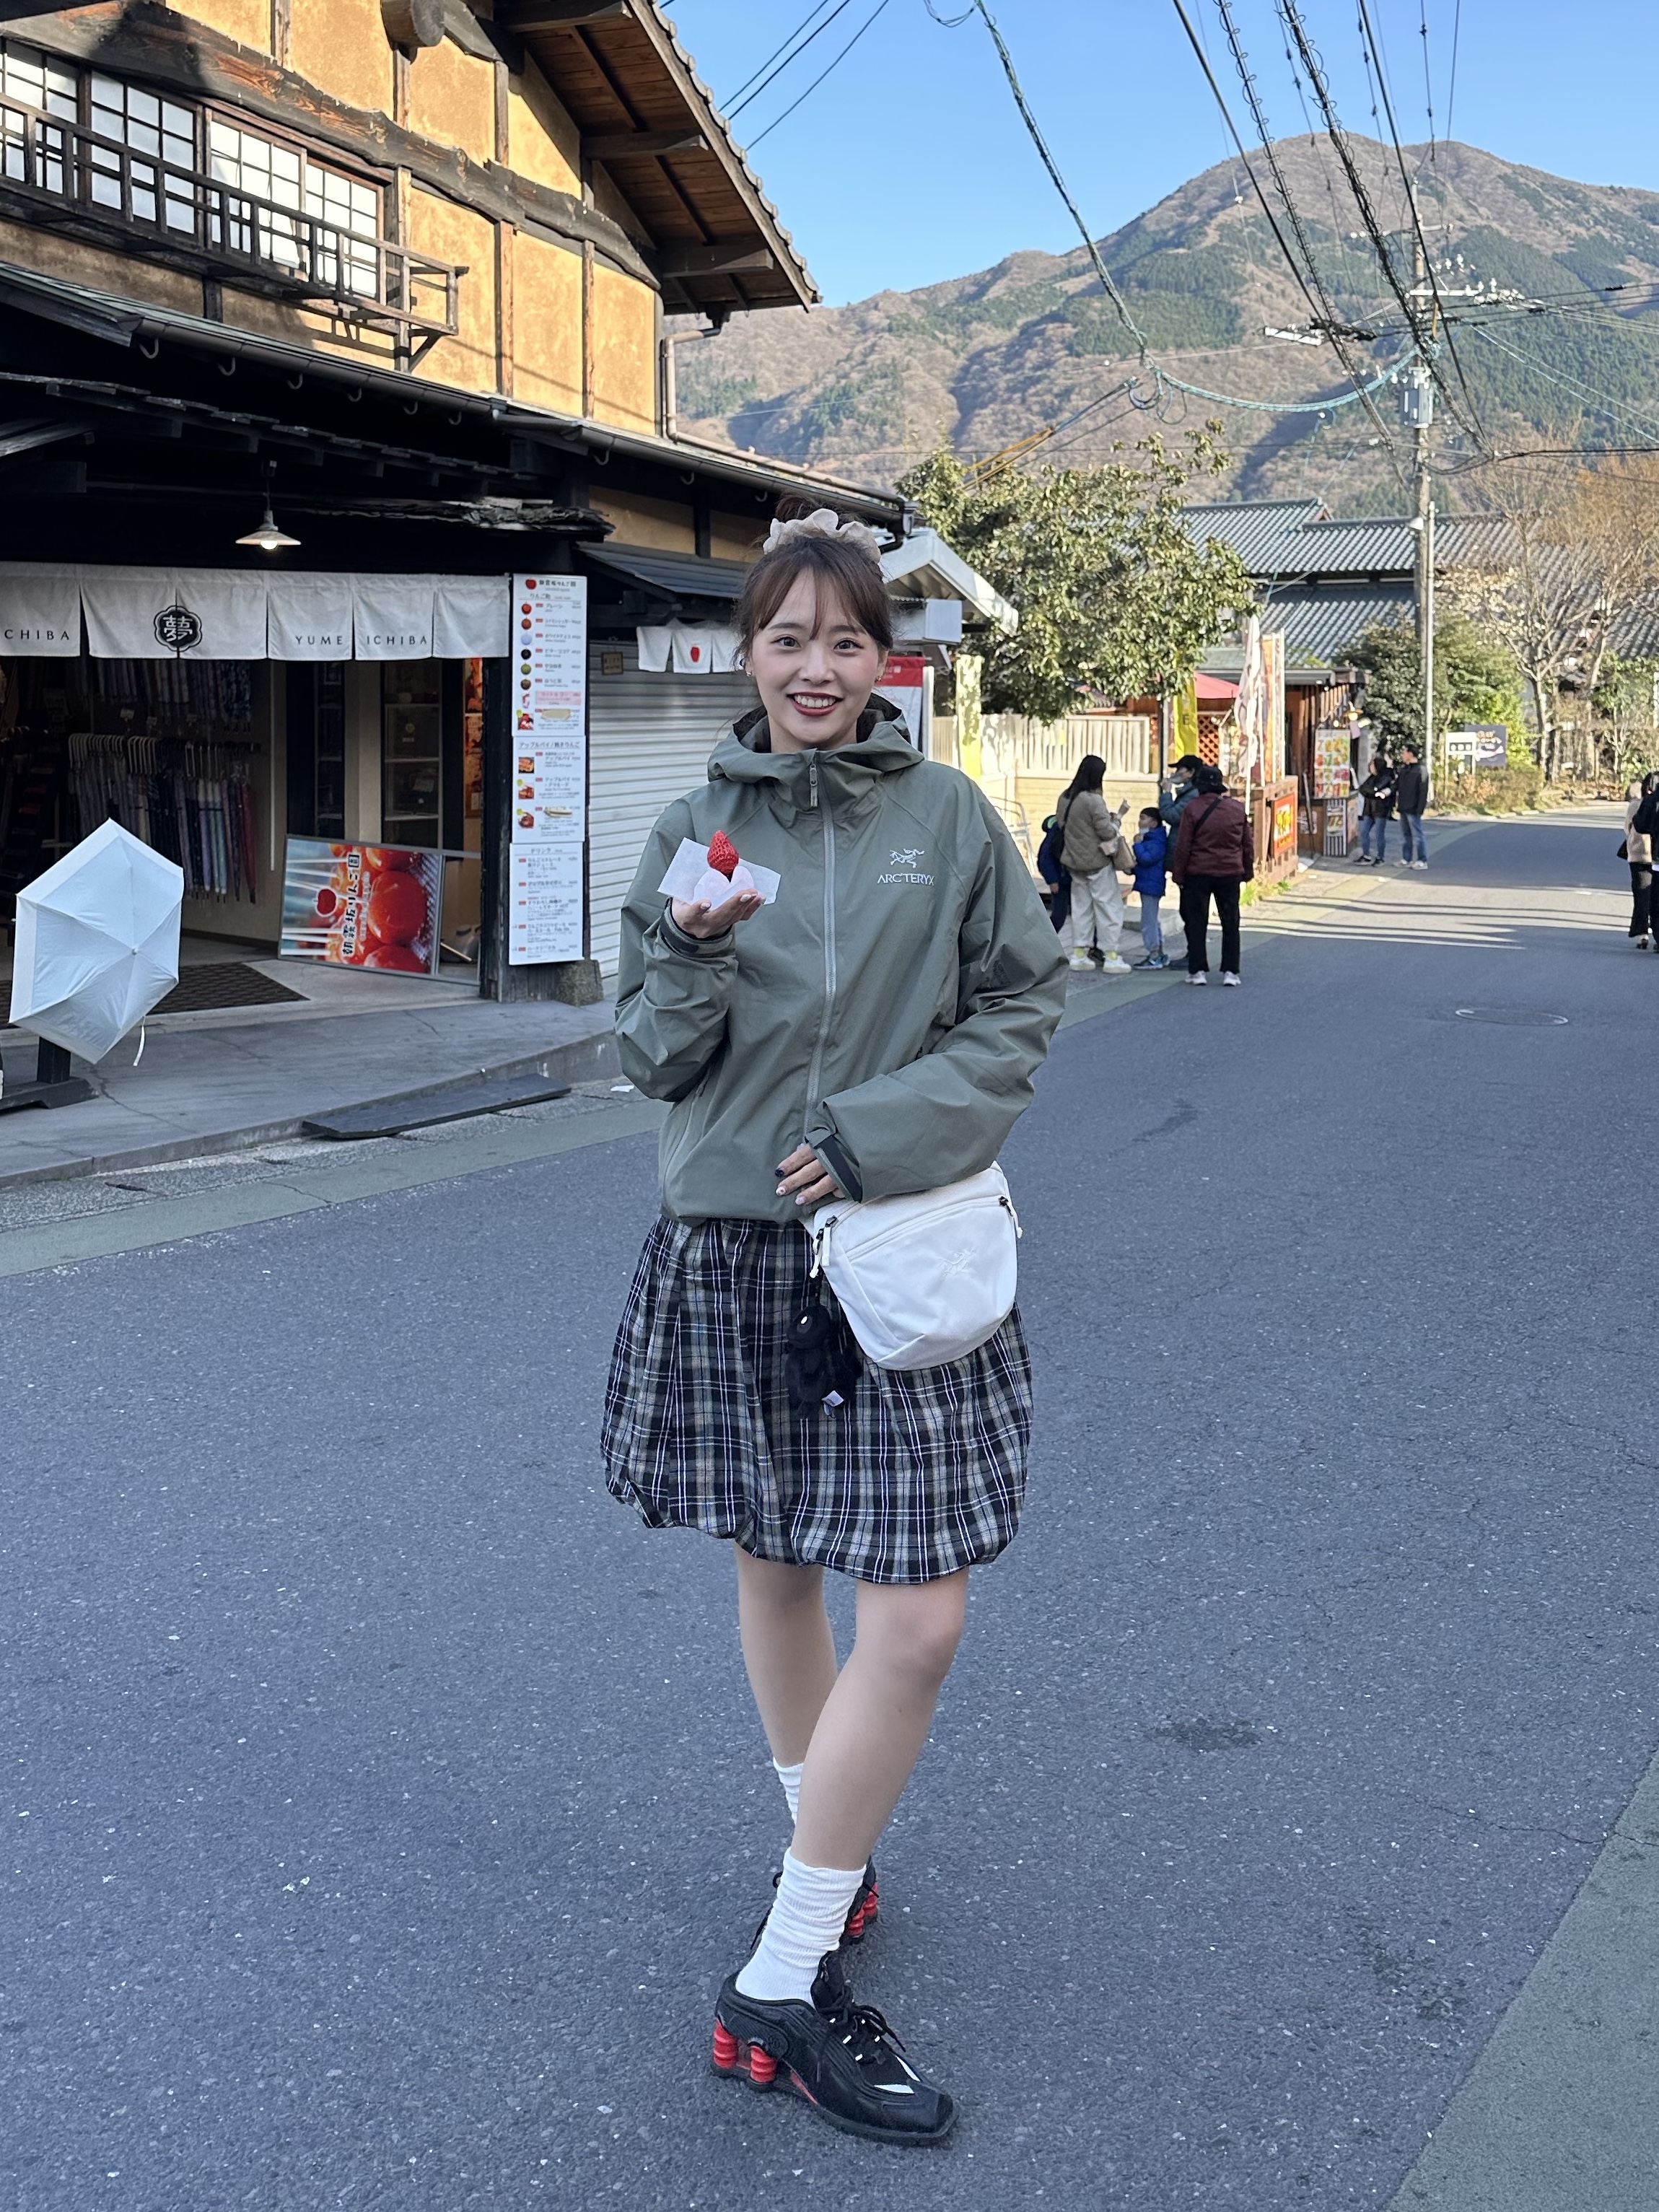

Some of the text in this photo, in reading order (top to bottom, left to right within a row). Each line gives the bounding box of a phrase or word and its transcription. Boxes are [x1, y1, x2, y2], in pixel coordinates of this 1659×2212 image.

[295, 635, 427, 645] YUME ICHIBA
[877, 873, 935, 886] ARC'TERYX
